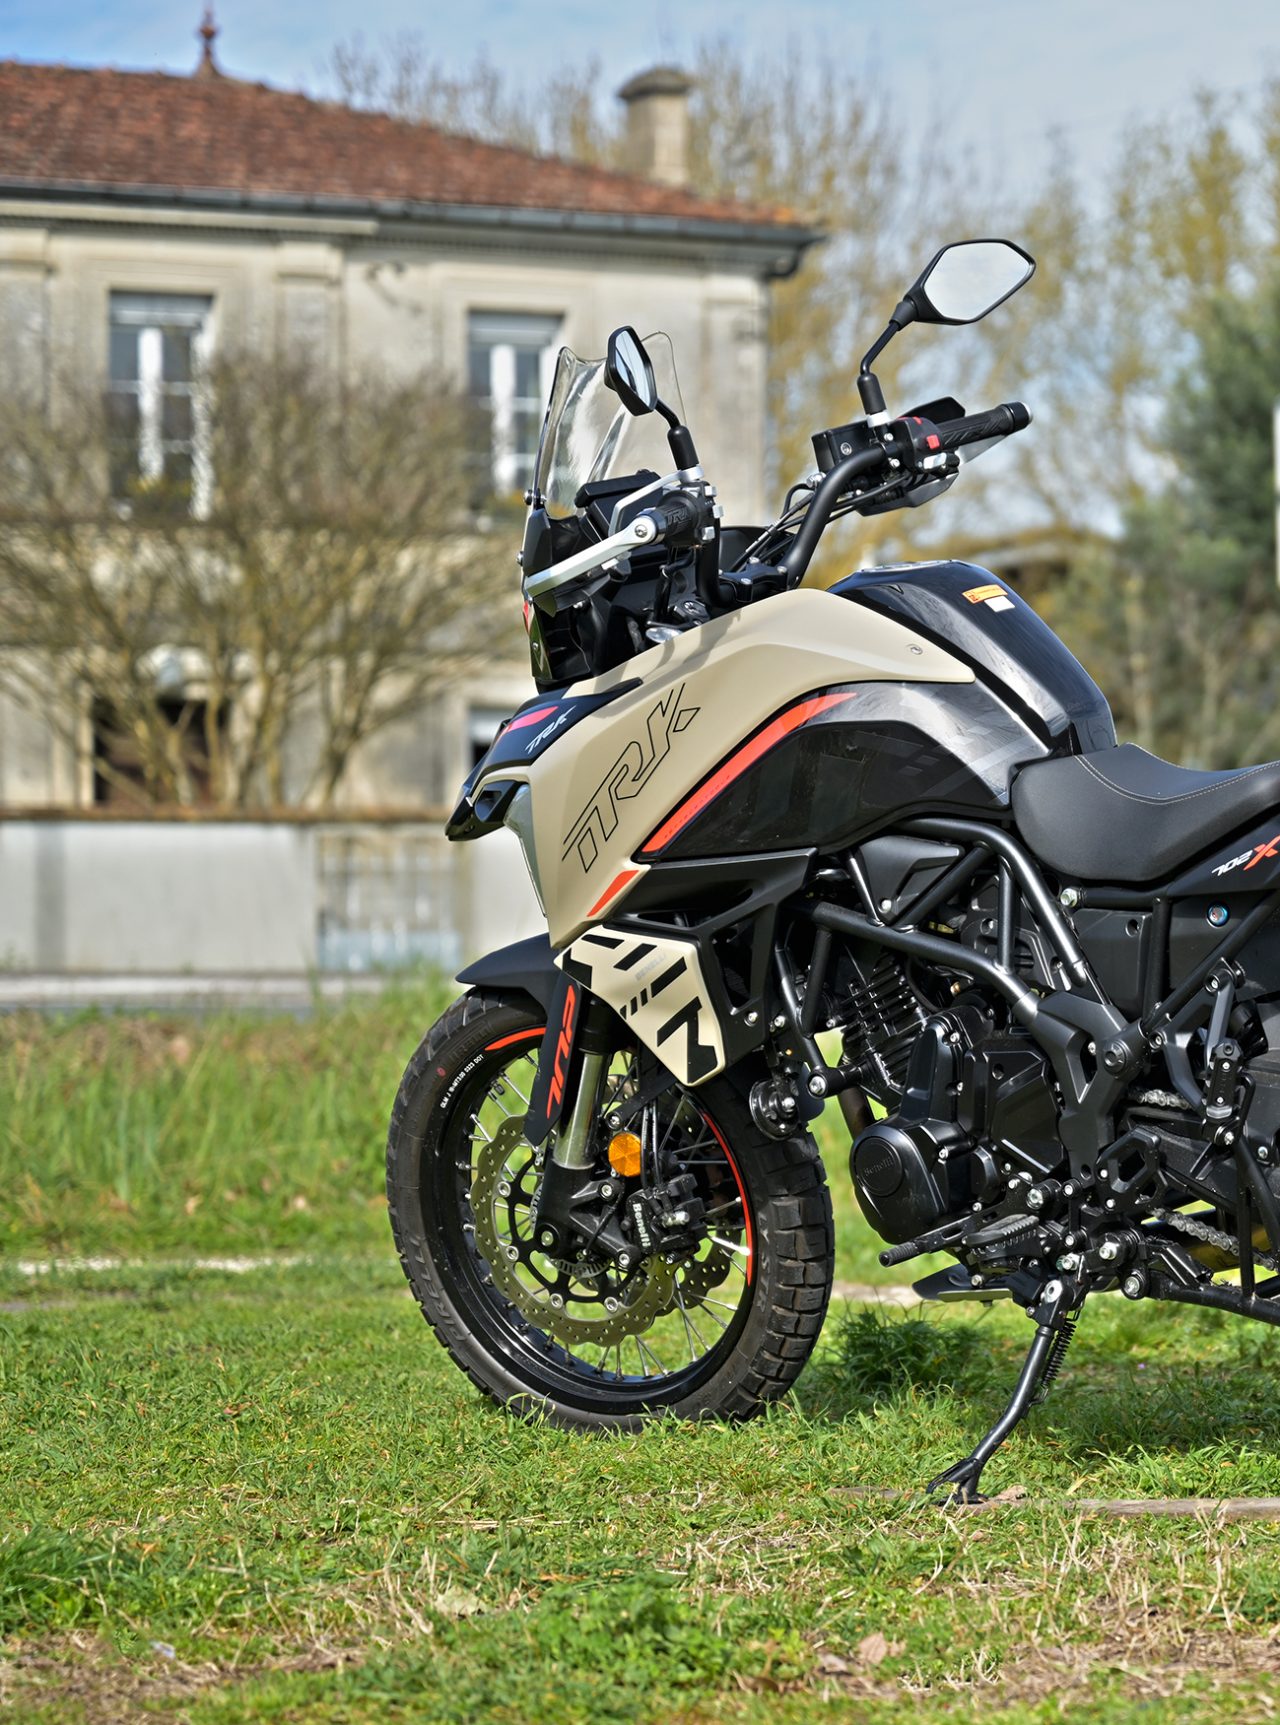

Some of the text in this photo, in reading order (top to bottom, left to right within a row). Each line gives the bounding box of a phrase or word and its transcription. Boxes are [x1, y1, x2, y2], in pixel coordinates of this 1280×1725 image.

[525, 705, 576, 754] TRK
[562, 683, 700, 873] TRK
[473, 1054, 484, 1064] DOT
[632, 1203, 651, 1248] Benelli
[409, 1236, 467, 1341] PIRELLI
